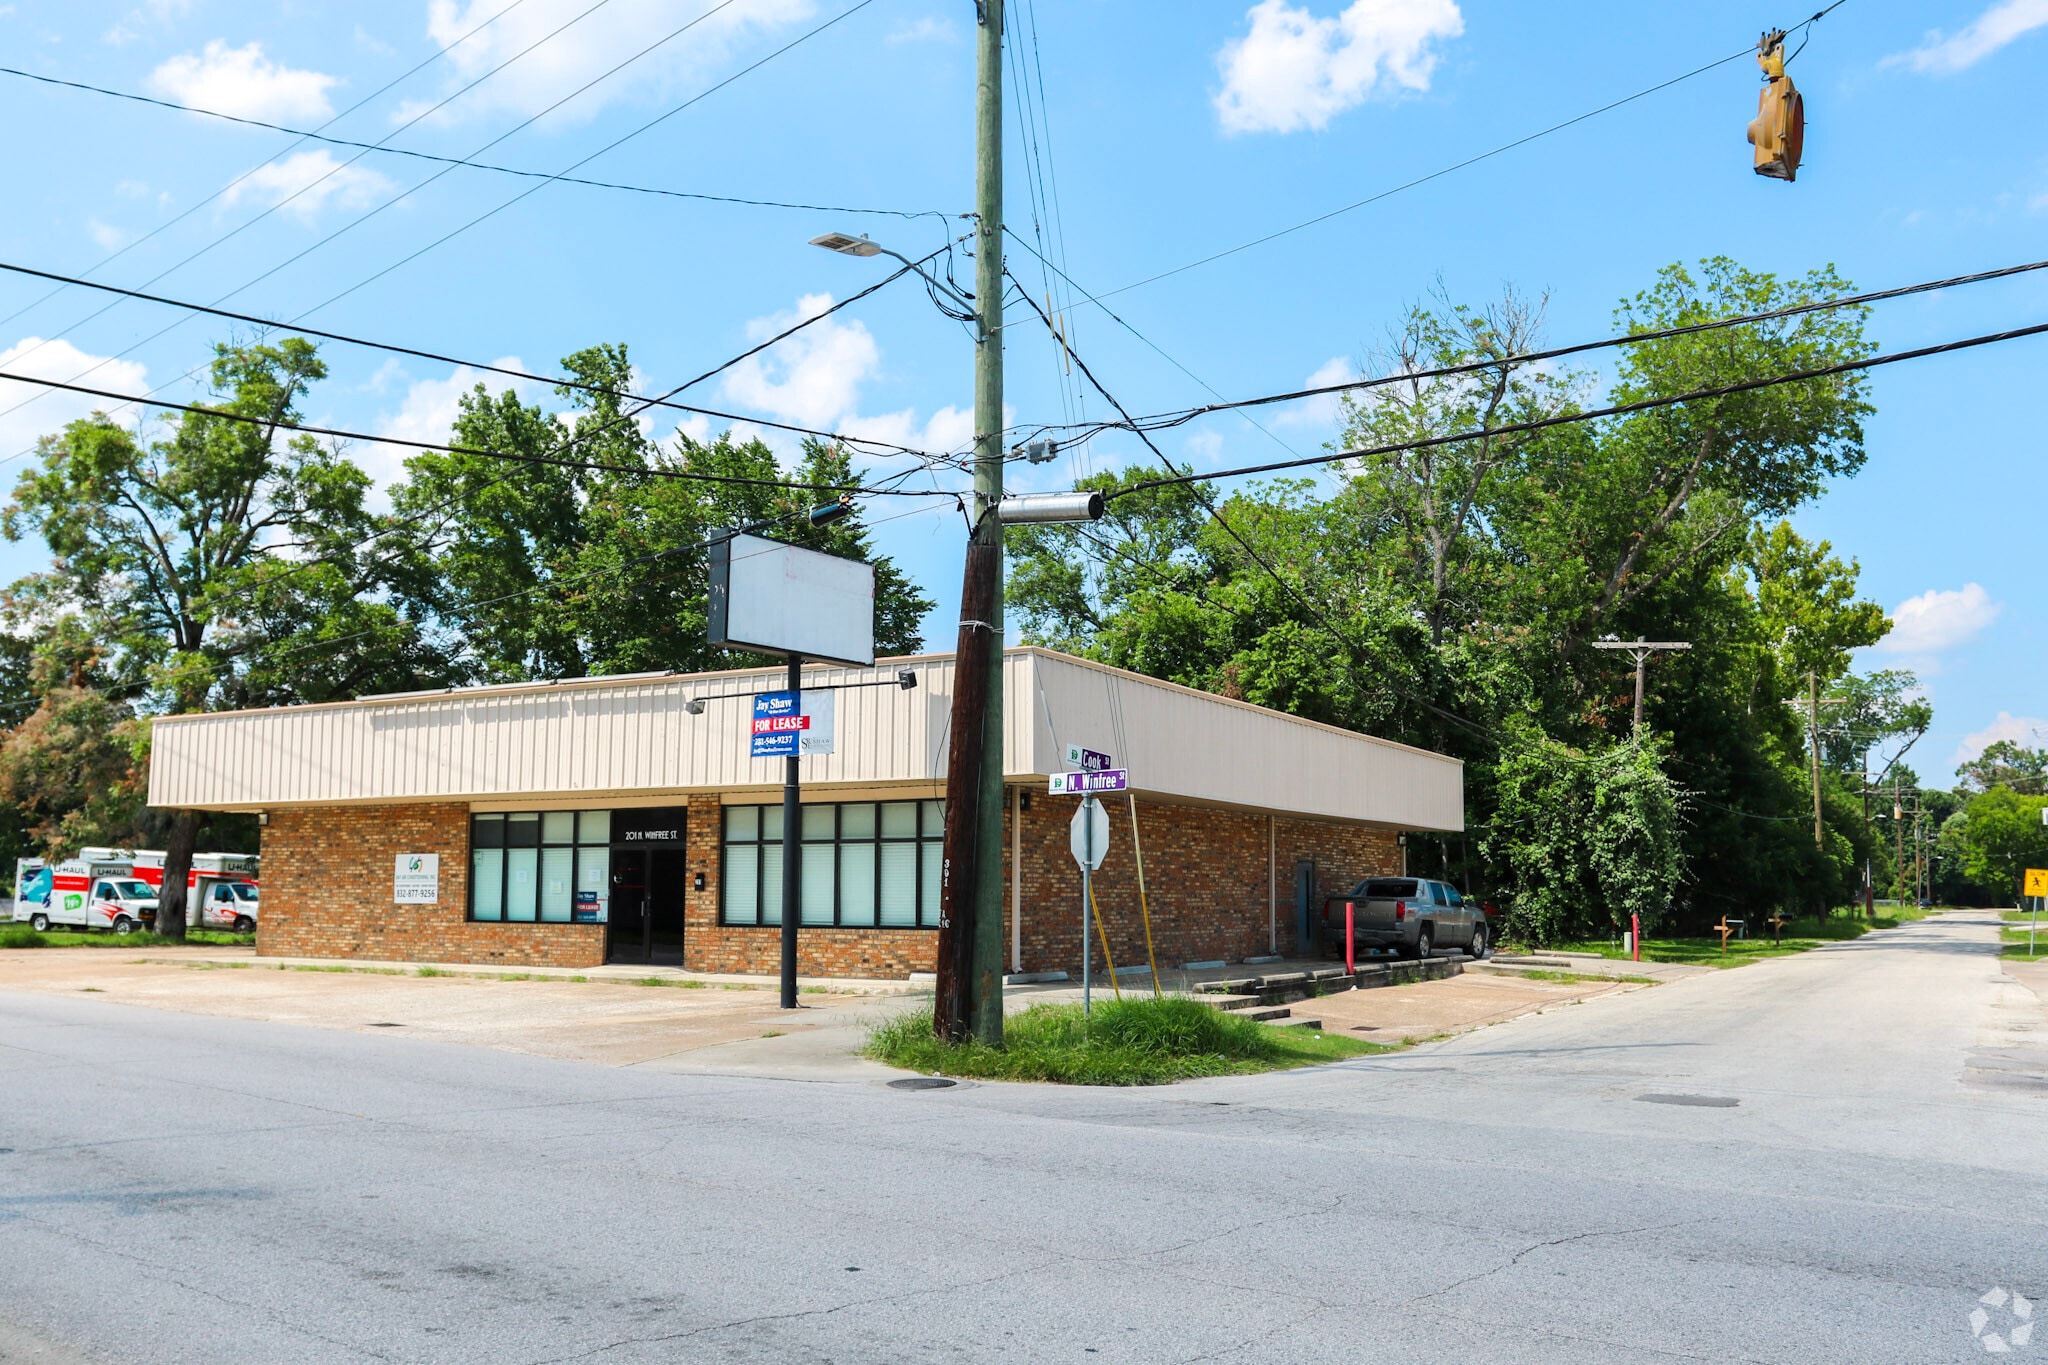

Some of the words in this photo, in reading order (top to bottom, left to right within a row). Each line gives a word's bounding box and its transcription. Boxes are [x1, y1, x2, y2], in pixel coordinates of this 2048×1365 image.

[756, 700, 769, 712] Jay
[770, 698, 792, 709] Shaw
[755, 720, 770, 732] FOR
[773, 717, 803, 730] LEASE
[1083, 751, 1102, 770] Cook
[1068, 775, 1078, 790] N.
[1082, 774, 1117, 789] Winfree
[625, 831, 637, 840] 201
[645, 830, 669, 840] WINFREE
[97, 868, 127, 876] U-HAUL
